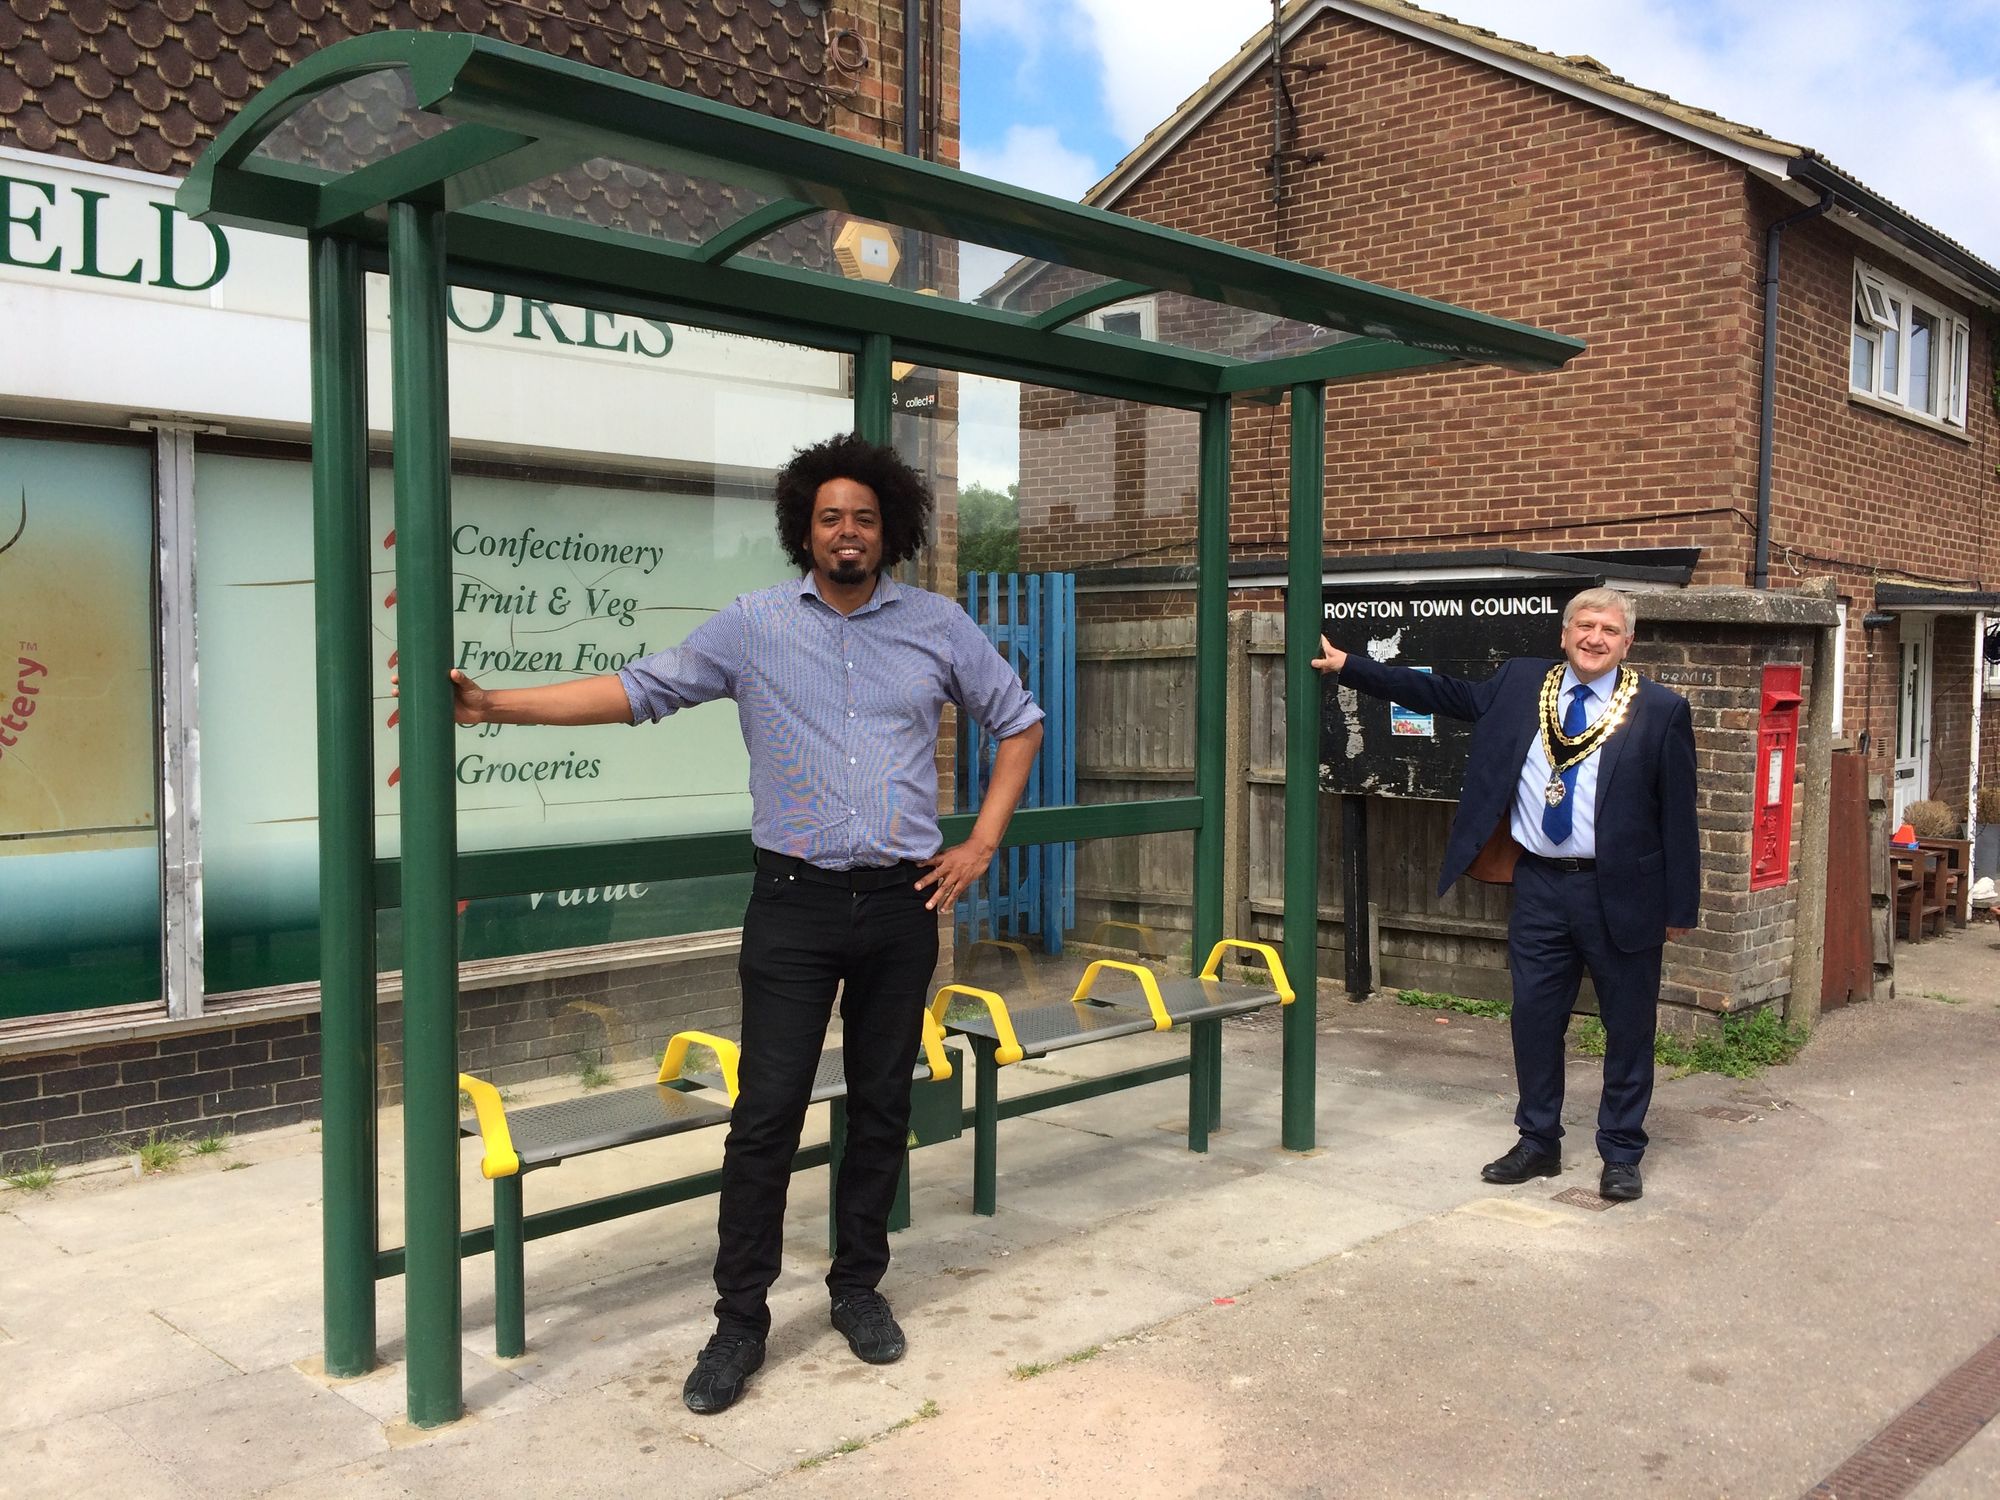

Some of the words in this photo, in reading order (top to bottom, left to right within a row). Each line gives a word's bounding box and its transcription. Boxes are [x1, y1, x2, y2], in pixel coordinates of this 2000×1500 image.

[452, 525, 664, 575] Confectionery
[454, 583, 538, 615] Fruit
[548, 586, 571, 616] &
[586, 587, 639, 627] Veg
[1324, 601, 1403, 619] ROYSTON
[1410, 599, 1463, 618] TOWN
[1470, 595, 1559, 616] COUNCIL
[456, 641, 563, 672] Frozen
[572, 643, 653, 672] Food
[456, 750, 601, 785] Groceries
